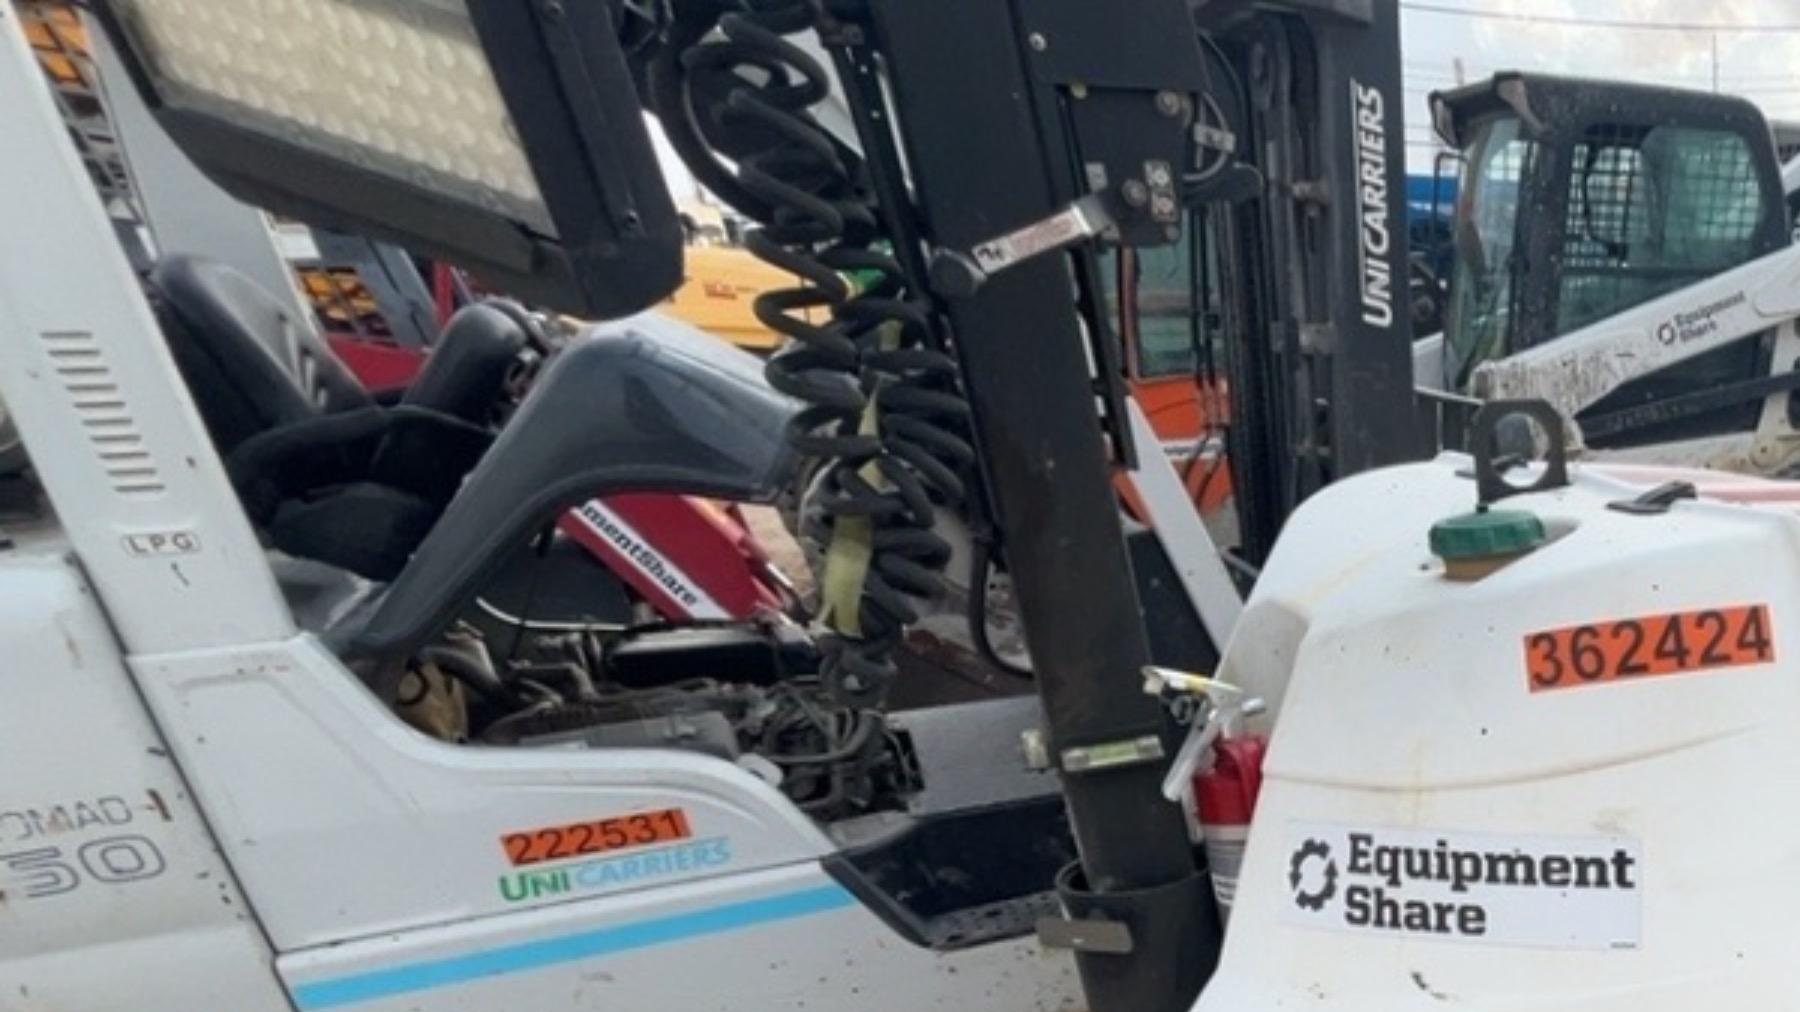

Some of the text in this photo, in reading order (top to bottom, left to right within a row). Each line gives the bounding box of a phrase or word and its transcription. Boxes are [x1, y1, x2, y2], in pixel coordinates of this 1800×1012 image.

[128, 532, 194, 552] LPG
[582, 506, 698, 605] mentShare
[1529, 606, 1770, 686] 362424
[504, 809, 686, 867] 222531
[1347, 833, 1635, 892] Equipment
[1345, 884, 1486, 936] Share
